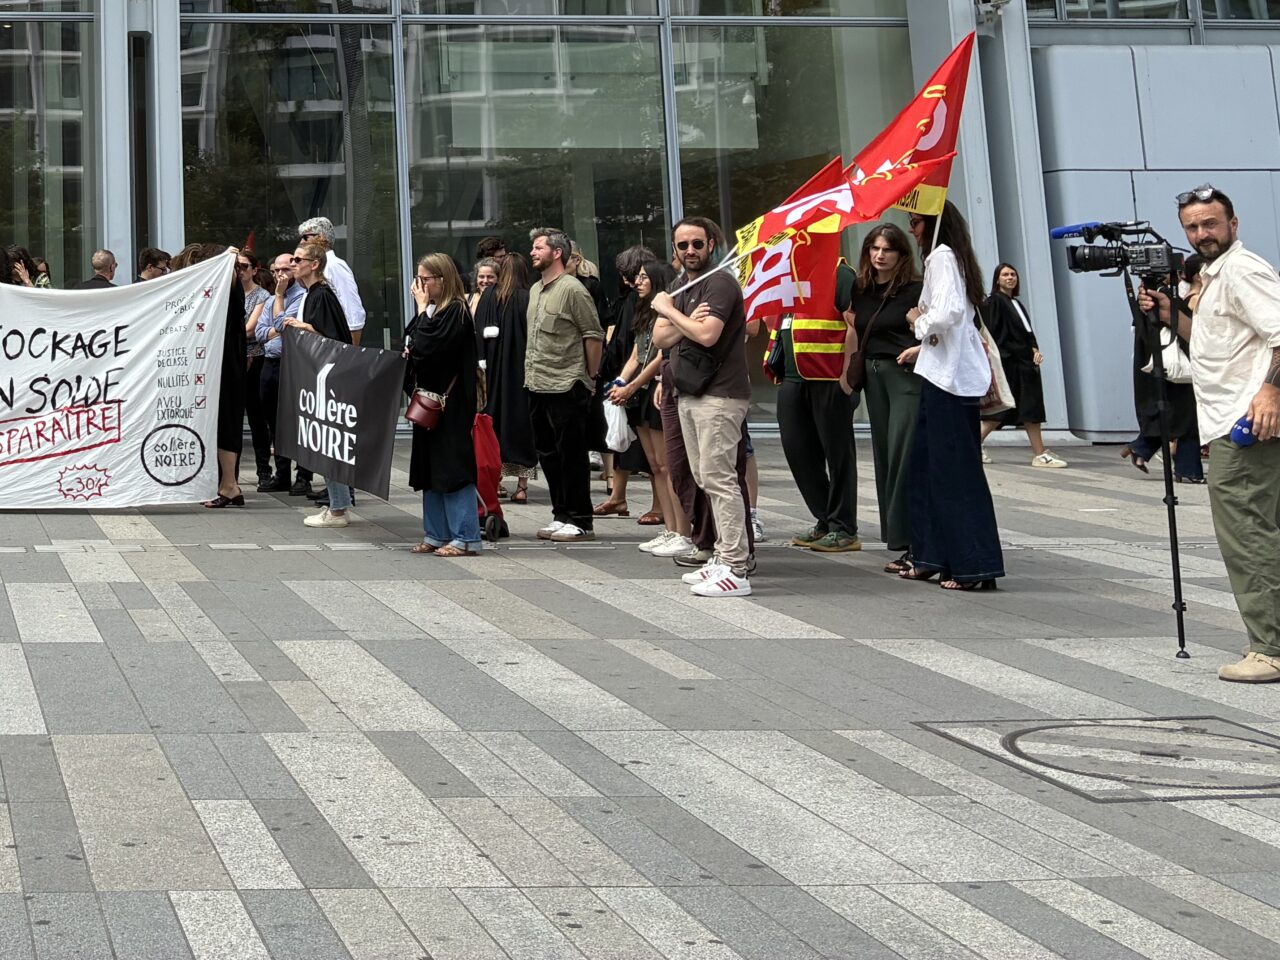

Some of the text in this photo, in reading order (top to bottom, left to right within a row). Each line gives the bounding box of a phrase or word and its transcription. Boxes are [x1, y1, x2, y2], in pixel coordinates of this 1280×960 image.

[157, 347, 187, 357] JUSTICE
[157, 372, 190, 388] NULLITÉS
[25, 367, 127, 415] SOLDE
[157, 395, 182, 409] AVEU
[297, 415, 357, 466] NOIRE
[154, 452, 196, 468] NOIRE
